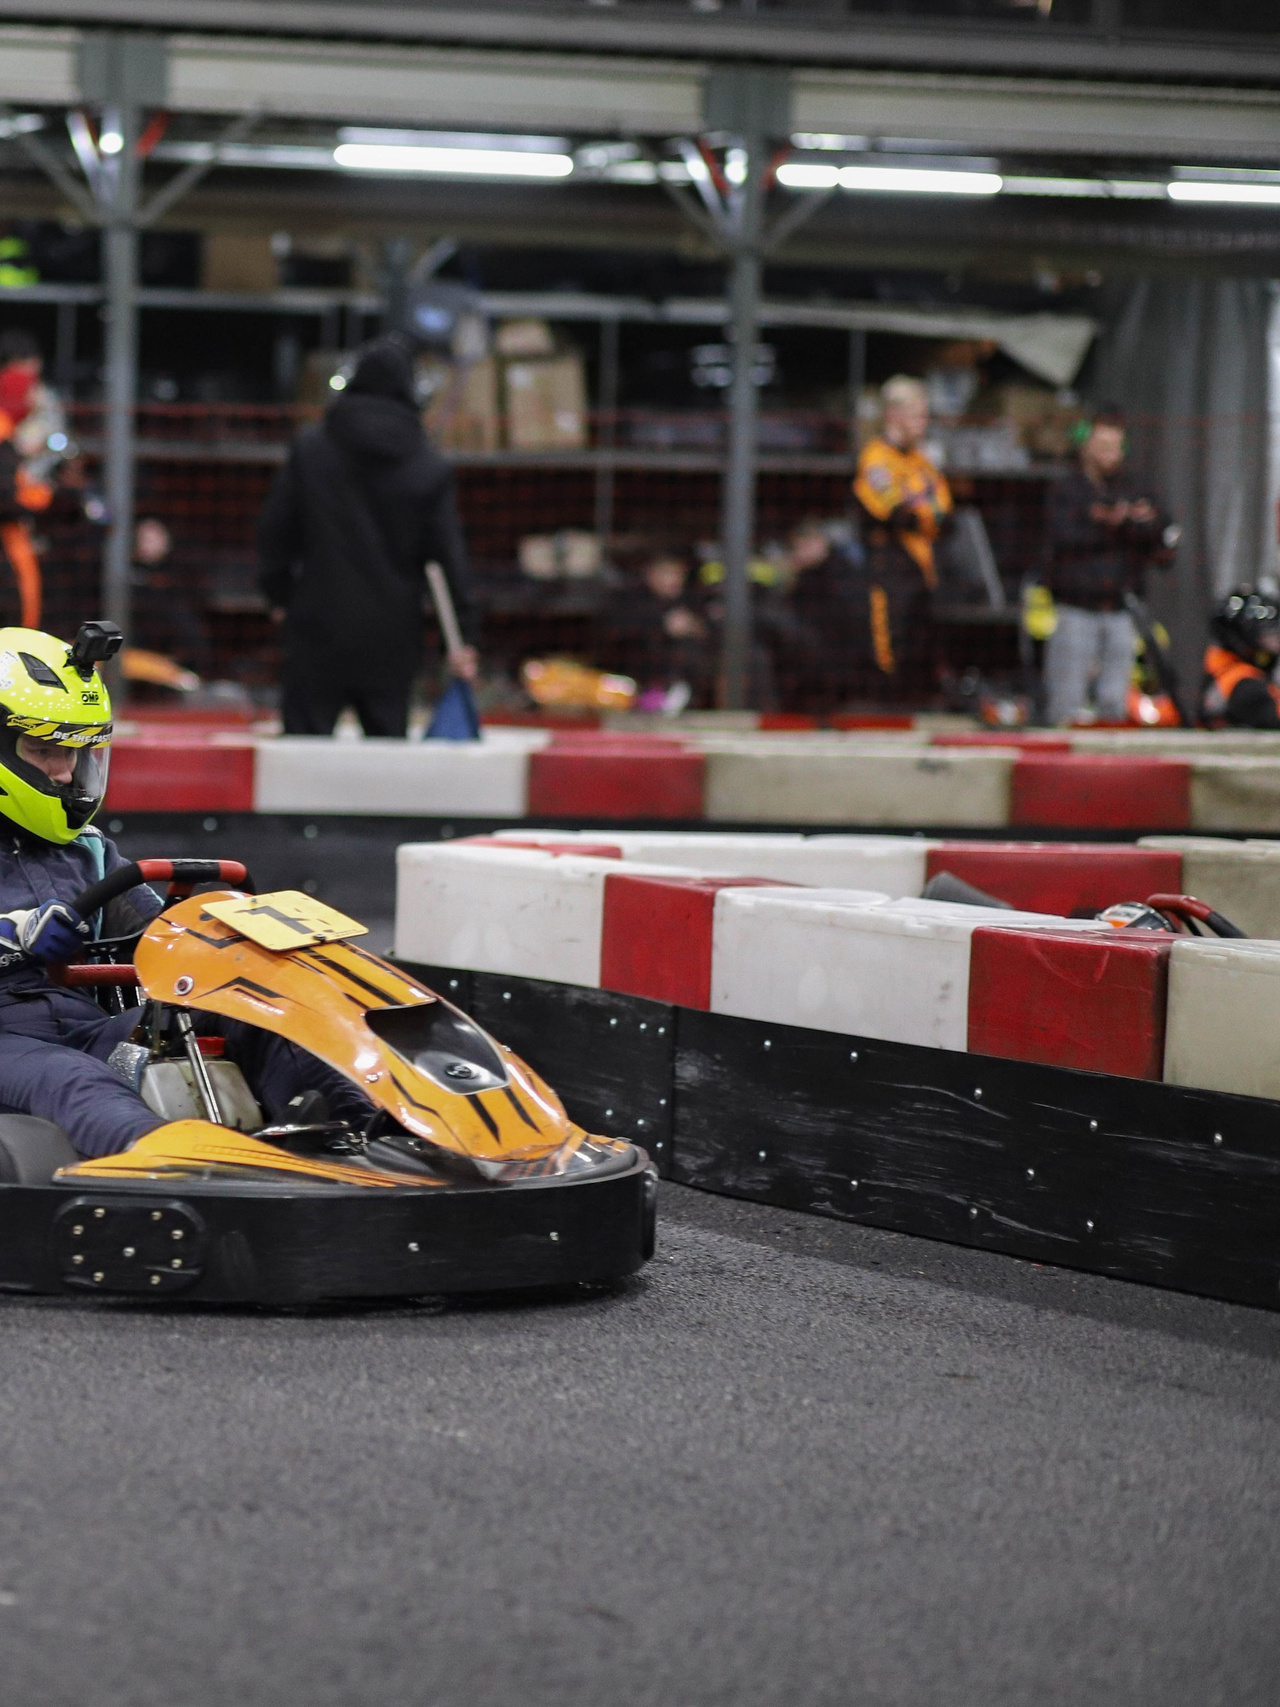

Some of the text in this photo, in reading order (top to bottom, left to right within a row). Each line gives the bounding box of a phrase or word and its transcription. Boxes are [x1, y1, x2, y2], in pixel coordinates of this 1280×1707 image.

[82, 693, 99, 703] OMP
[53, 731, 69, 740] BE
[72, 734, 91, 743] THE
